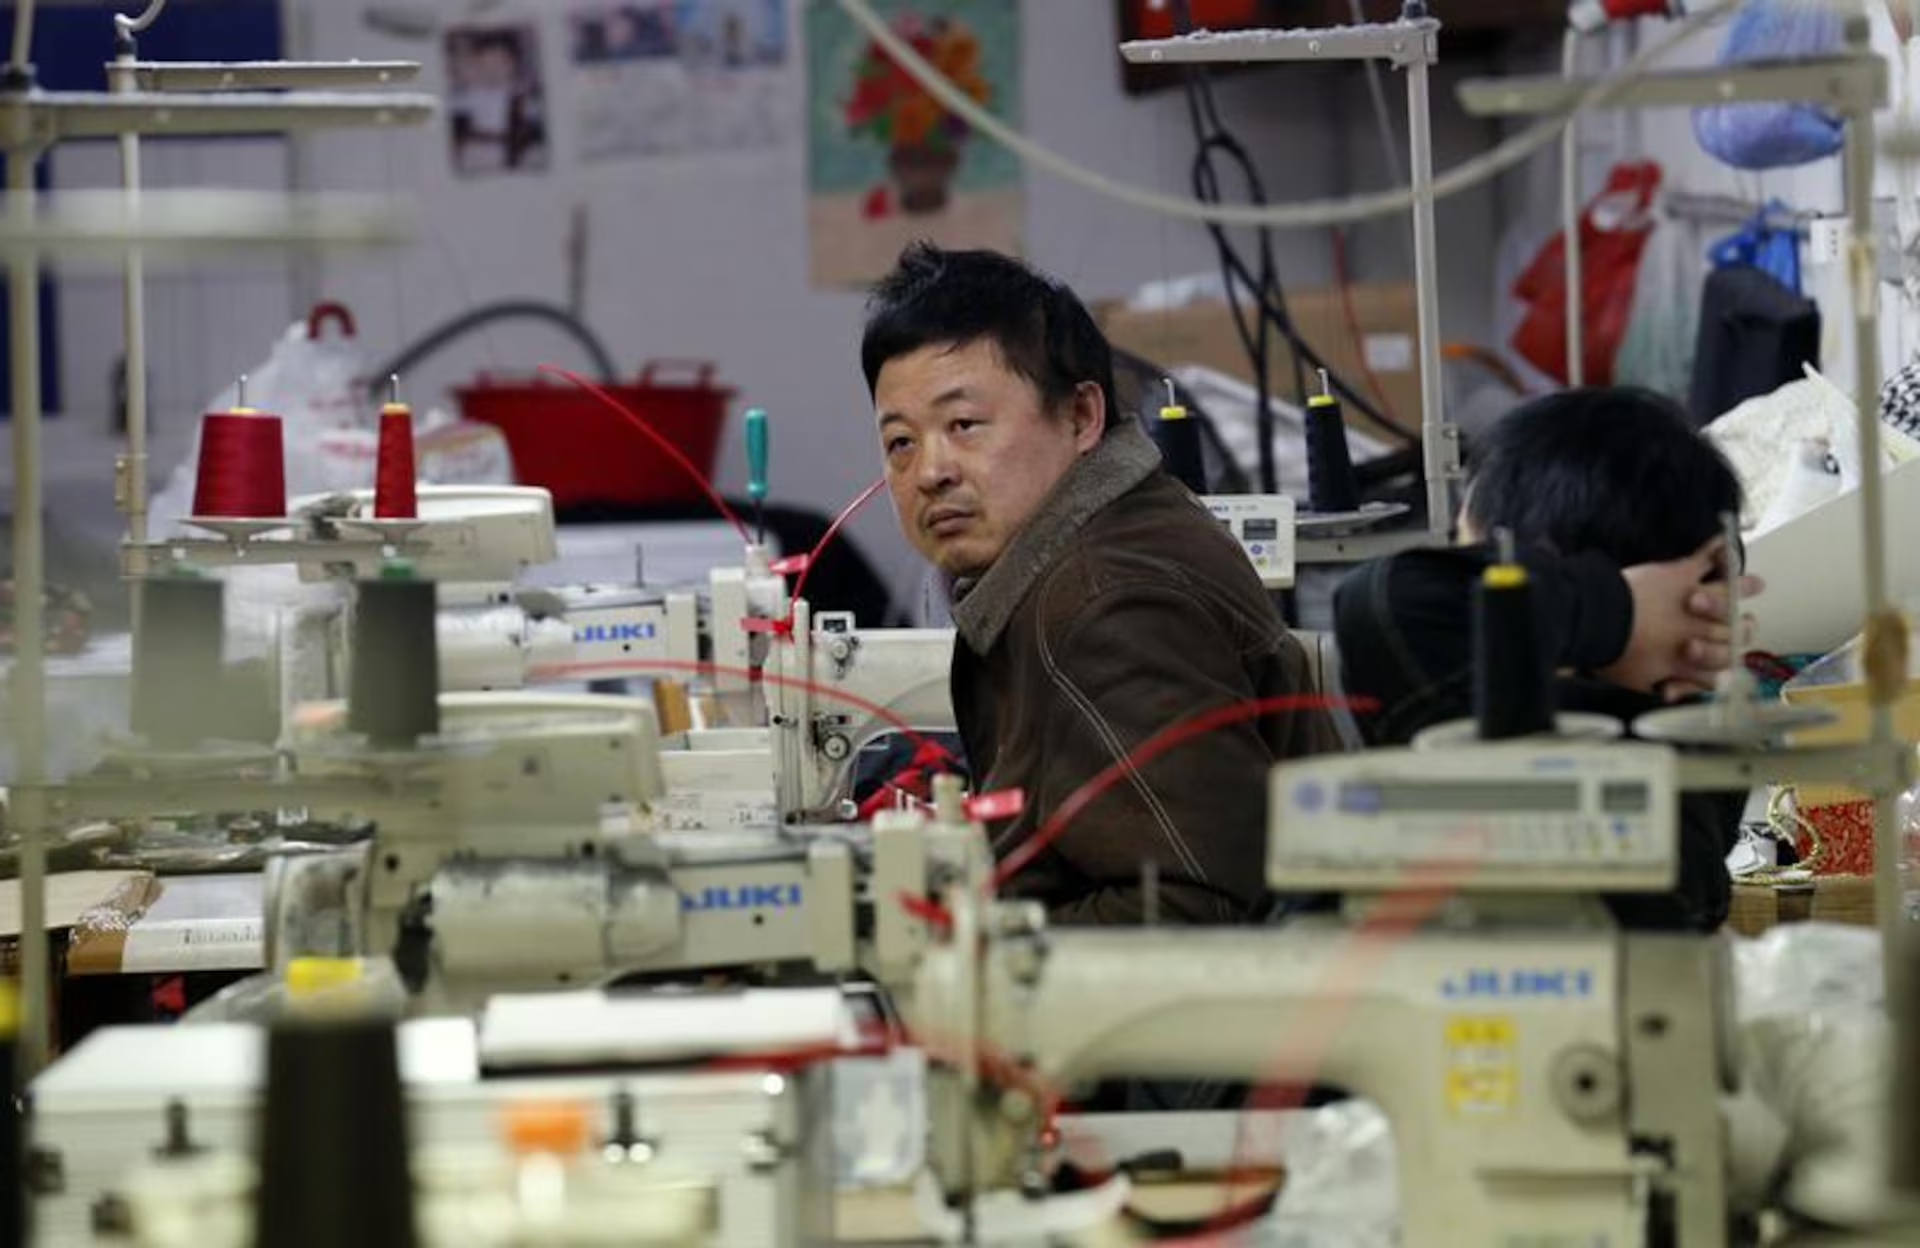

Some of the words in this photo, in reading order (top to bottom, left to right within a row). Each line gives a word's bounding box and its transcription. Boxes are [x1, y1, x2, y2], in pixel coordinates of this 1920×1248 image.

[574, 624, 655, 641] JUKI
[680, 885, 801, 911] JUKI
[1441, 968, 1592, 998] JUKI
